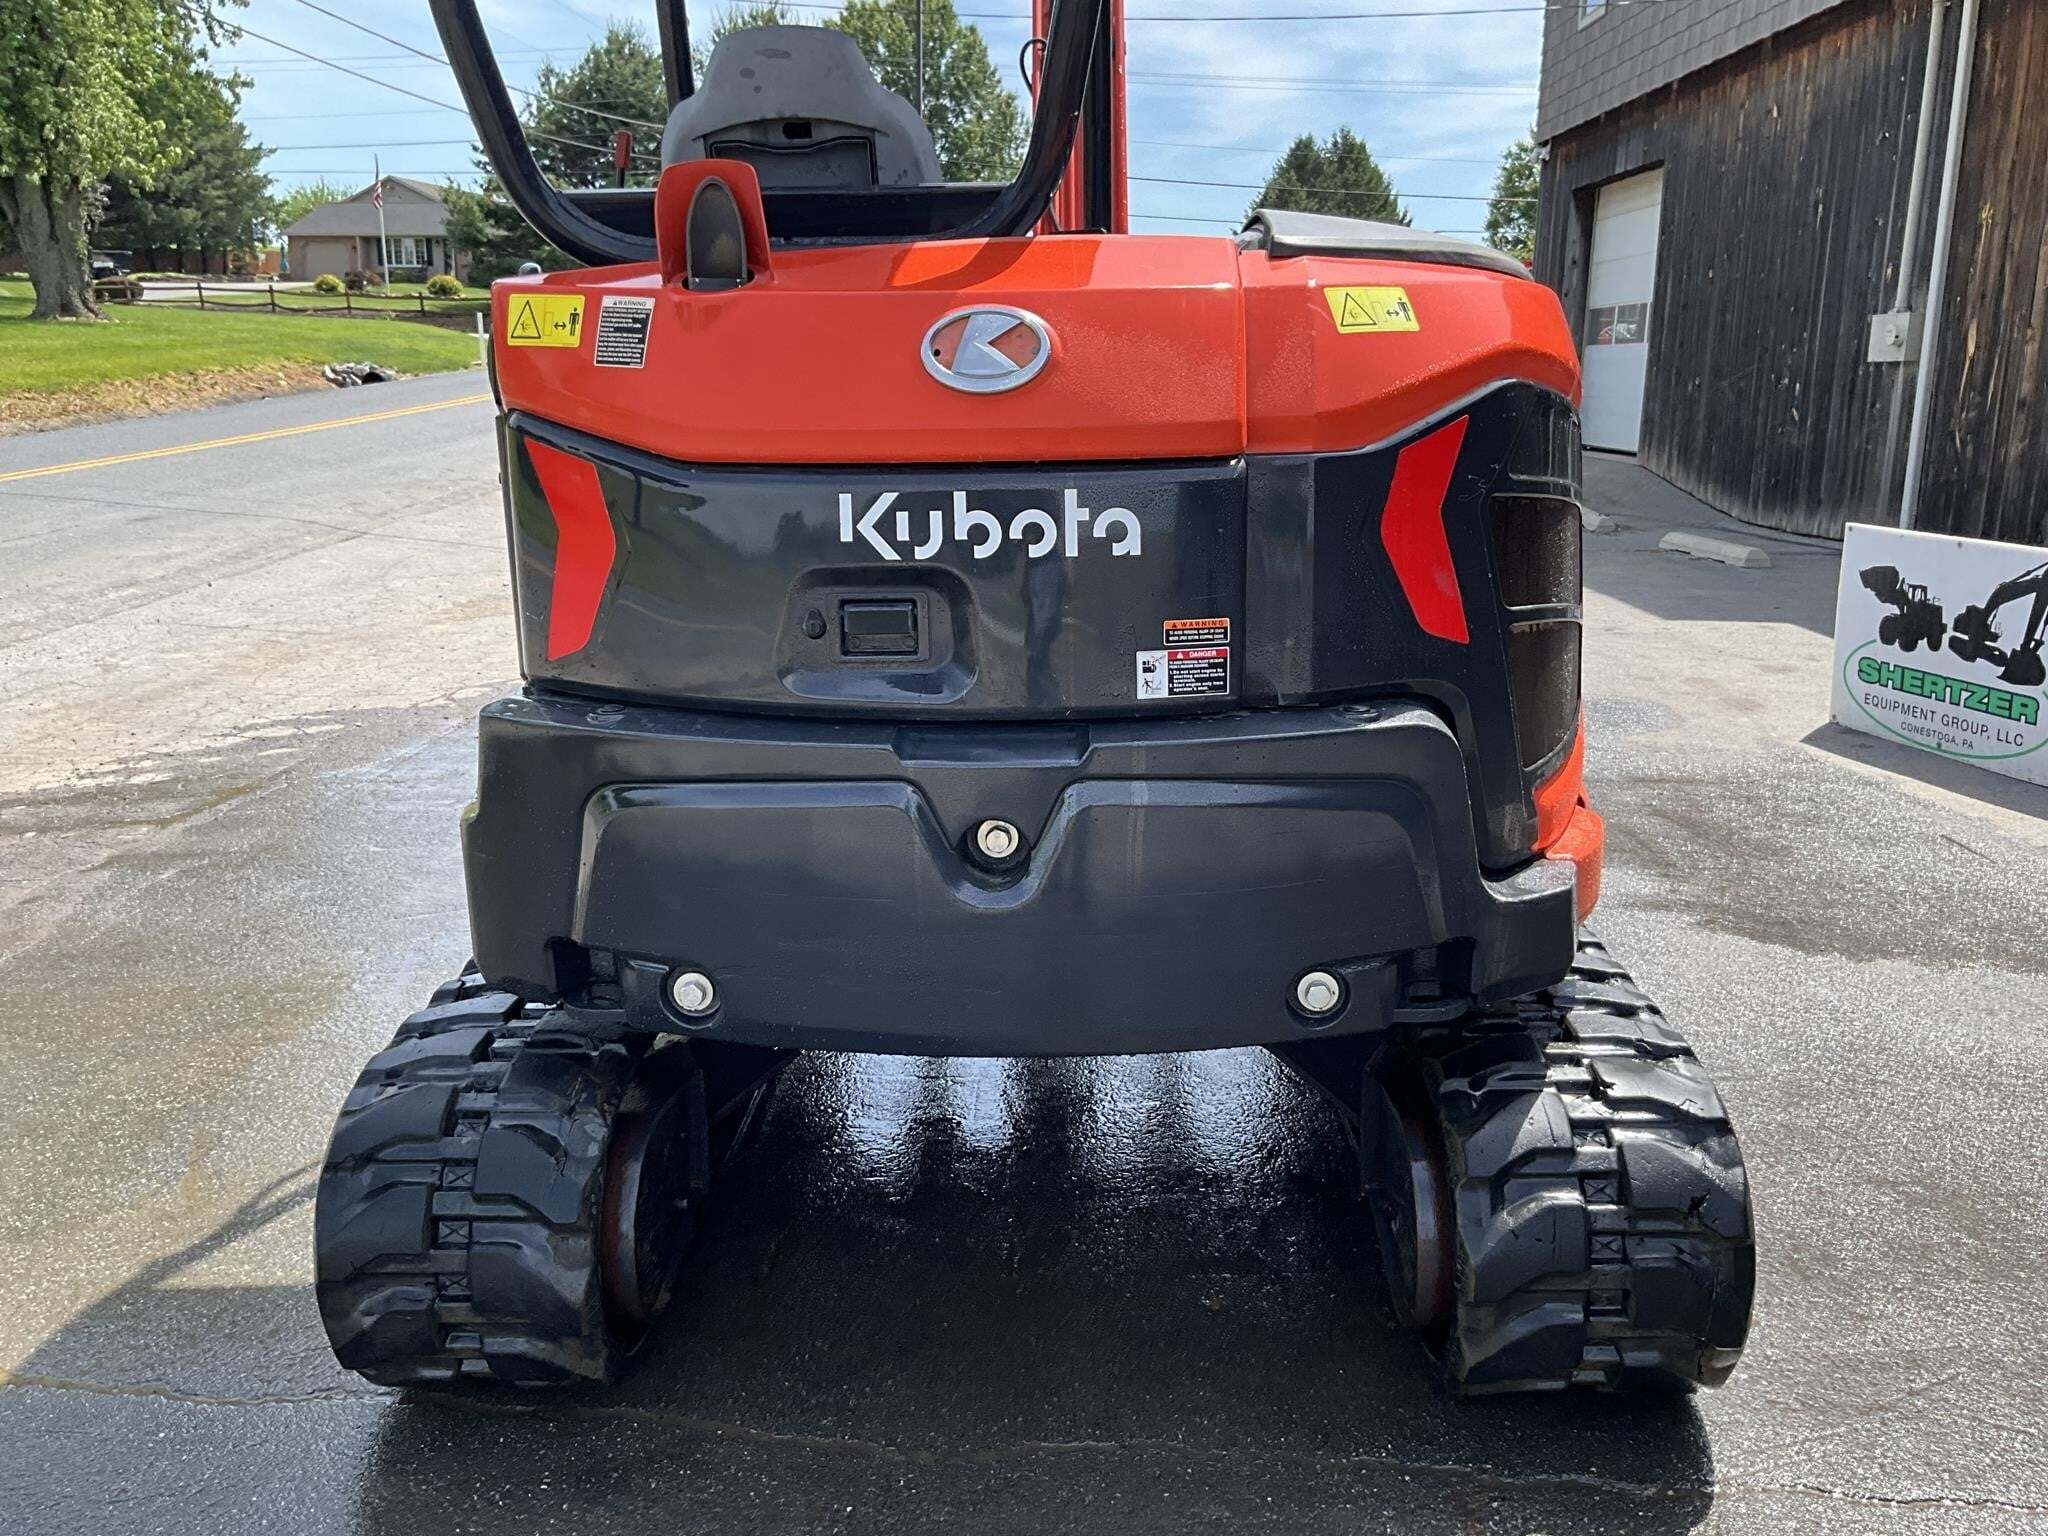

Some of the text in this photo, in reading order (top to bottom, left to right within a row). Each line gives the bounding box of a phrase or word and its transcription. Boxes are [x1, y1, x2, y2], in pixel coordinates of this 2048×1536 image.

[838, 488, 1142, 561] Kubota
[1858, 656, 2039, 726] SHERTZER
[1864, 693, 2024, 747] EQUIPMENT GROUP, LLC
[1900, 721, 1974, 750] CONESTOGA, PA
